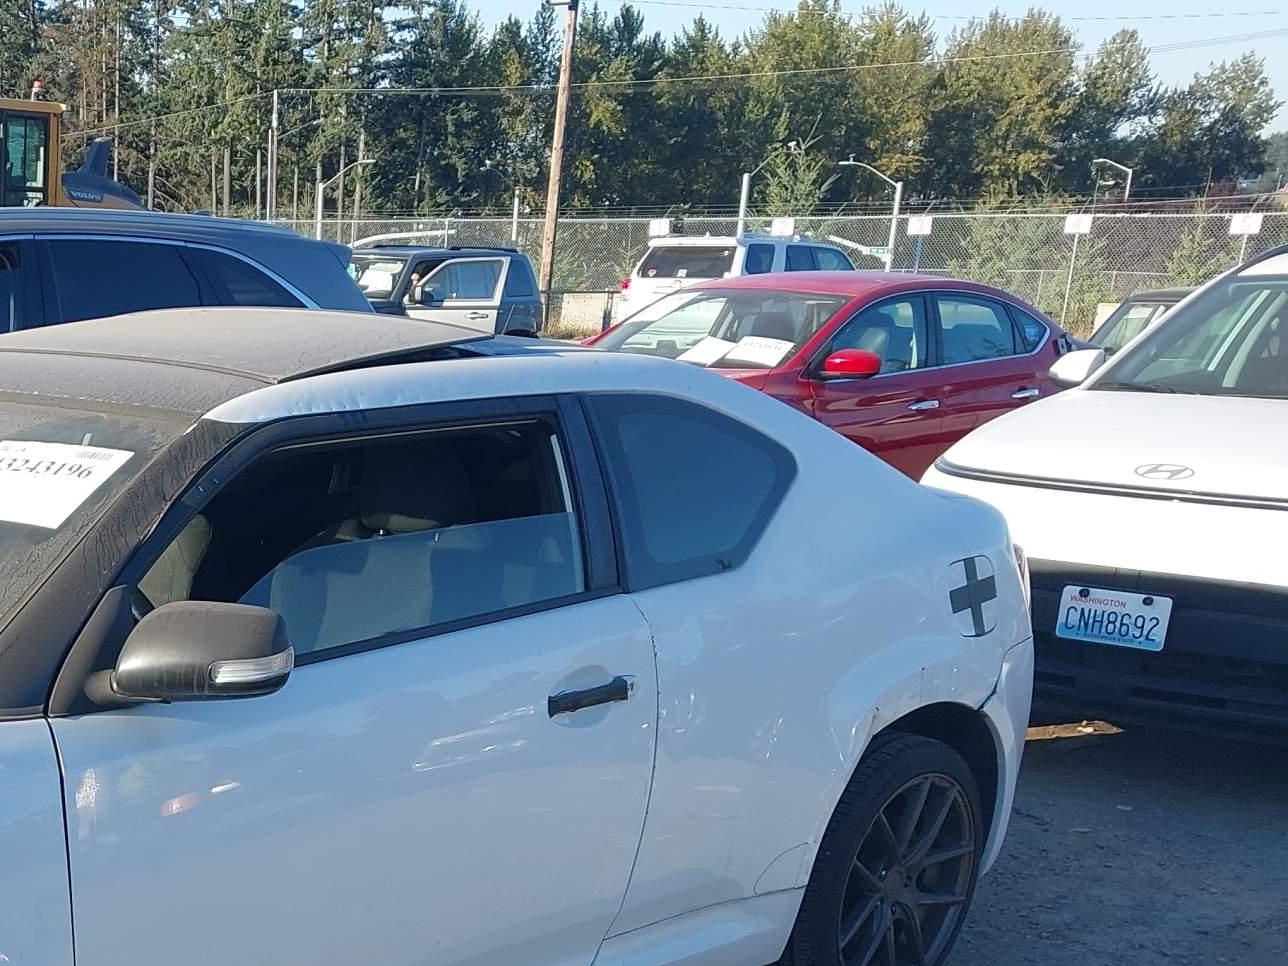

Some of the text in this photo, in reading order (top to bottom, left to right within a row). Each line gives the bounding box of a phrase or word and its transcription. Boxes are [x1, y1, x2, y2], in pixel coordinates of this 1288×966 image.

[70, 190, 101, 200] VOLVO
[1070, 594, 1127, 608] WASHINGTON
[1064, 605, 1160, 642] CNH8692
